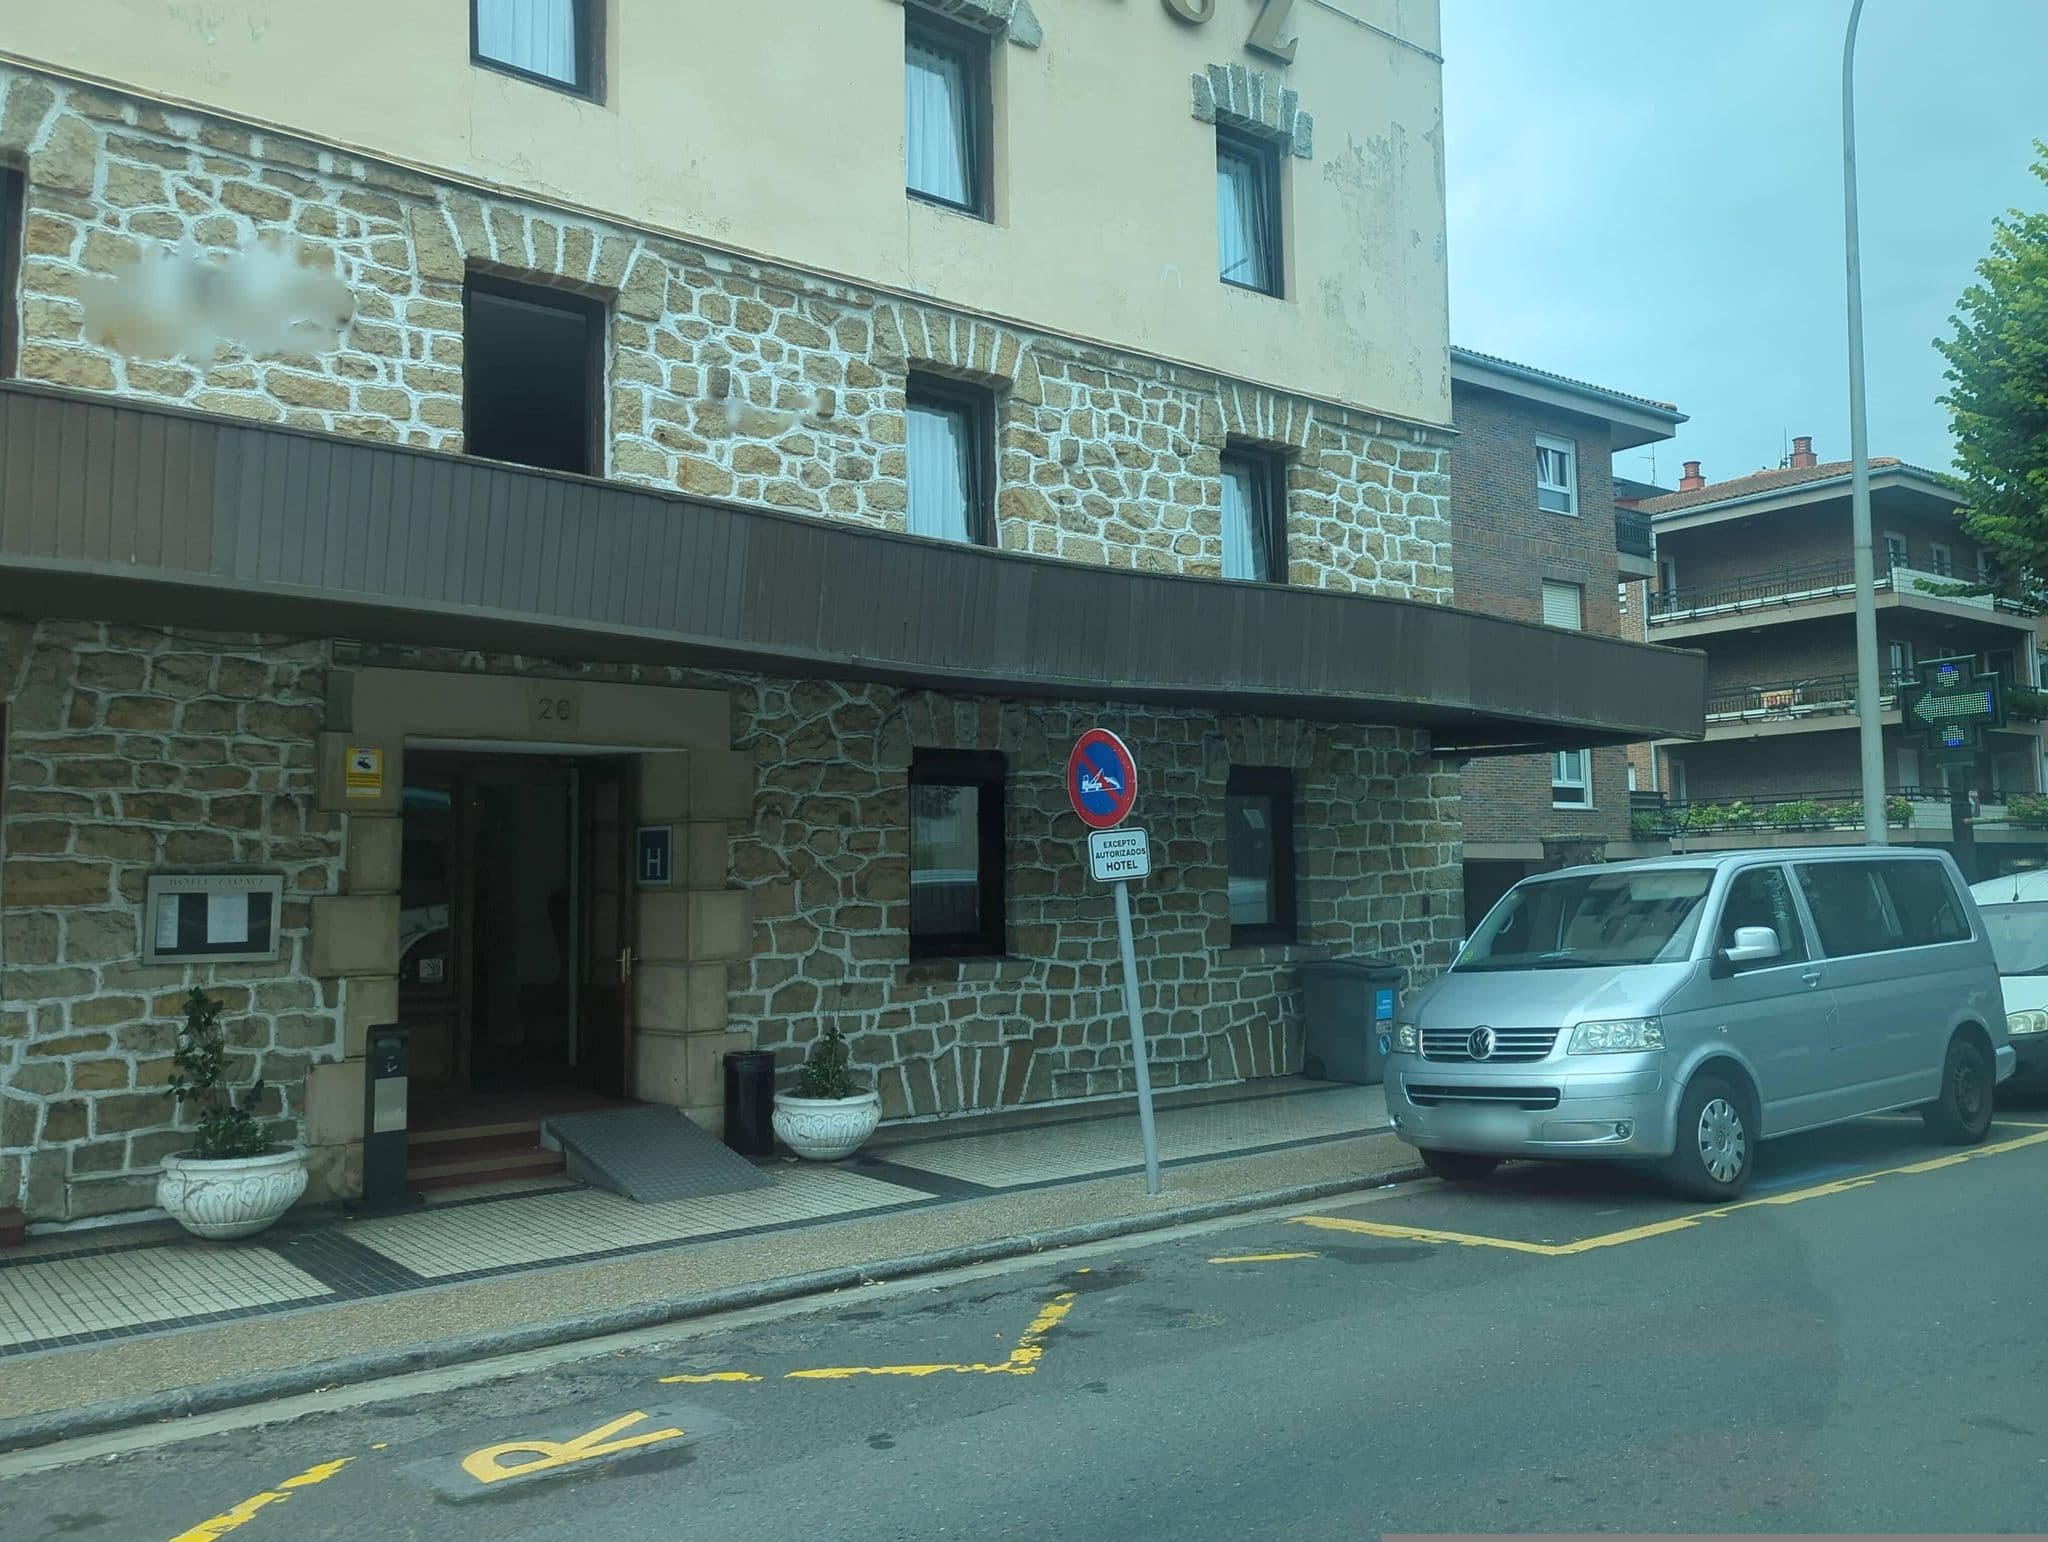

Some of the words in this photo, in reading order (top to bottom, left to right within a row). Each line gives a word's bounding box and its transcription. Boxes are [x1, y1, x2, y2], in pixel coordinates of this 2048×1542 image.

[1103, 838, 1137, 849] EXCEPTO
[1095, 847, 1146, 860] AUTORIZADOS
[646, 847, 662, 877] H
[1106, 860, 1138, 872] HOTEL
[461, 1410, 687, 1484] R
